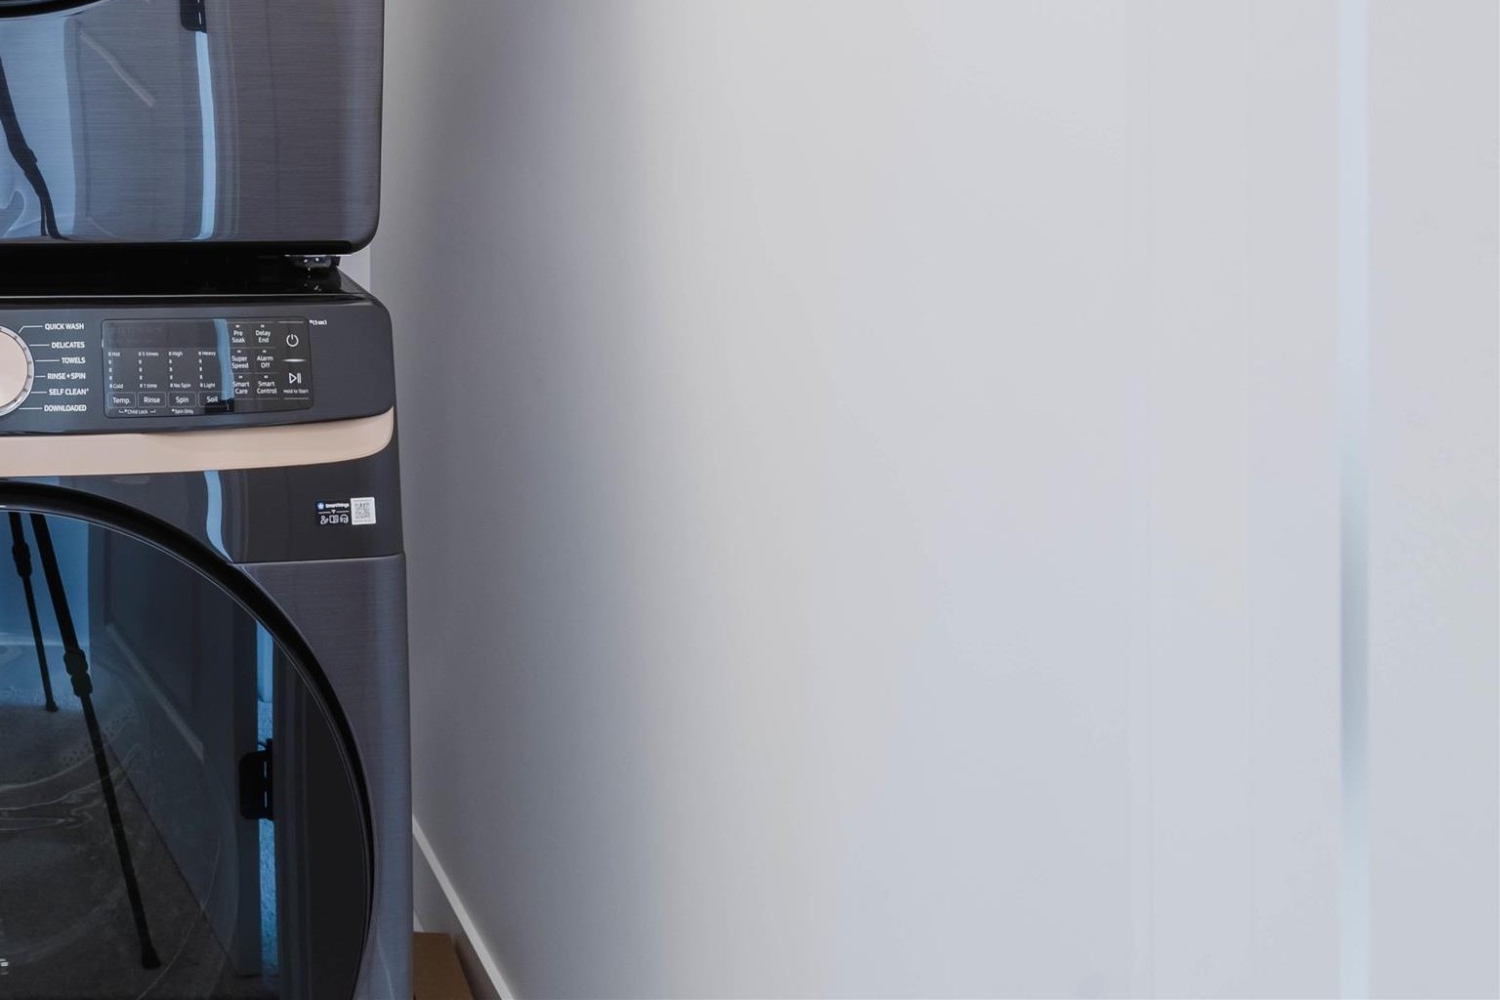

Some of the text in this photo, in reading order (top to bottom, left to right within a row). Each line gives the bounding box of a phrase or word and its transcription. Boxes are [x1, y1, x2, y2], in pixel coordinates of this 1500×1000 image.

[44, 322, 85, 330] QUICK WASH
[255, 330, 271, 338] Delay
[51, 341, 86, 349] DELICATES
[60, 356, 86, 364] TOWELS
[48, 388, 64, 396] SELF
[113, 397, 131, 405] Temp.
[175, 396, 189, 404] Spin
[44, 404, 88, 412] DOWNLOADED
